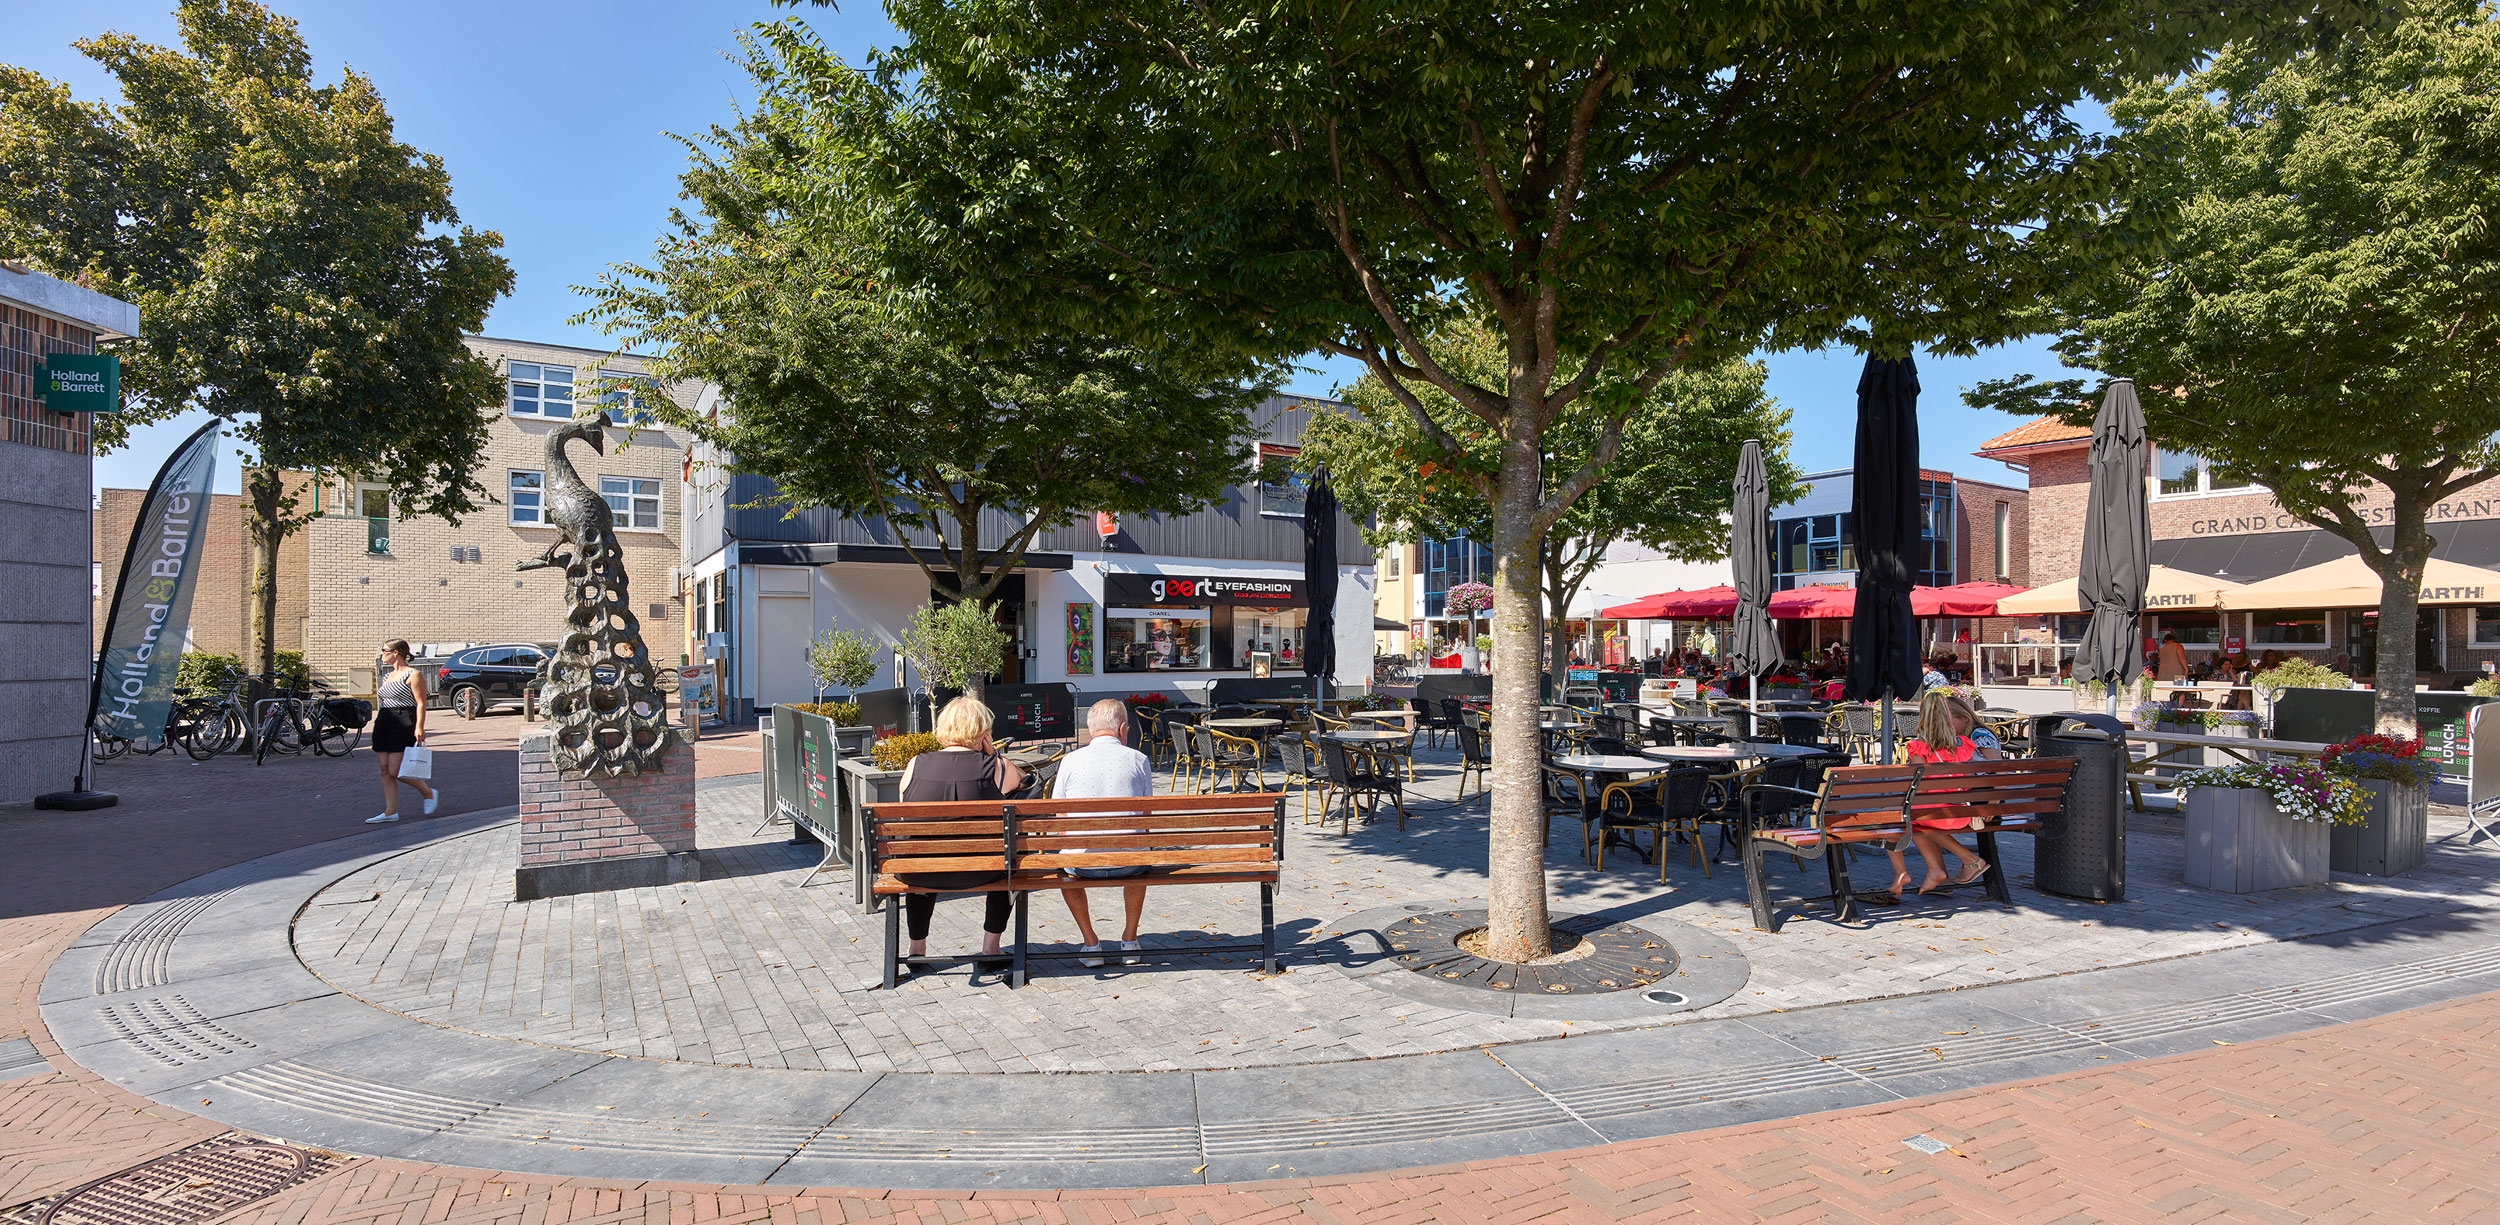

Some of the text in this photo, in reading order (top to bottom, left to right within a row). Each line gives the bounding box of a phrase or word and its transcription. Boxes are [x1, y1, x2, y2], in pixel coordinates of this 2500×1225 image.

[51, 370, 99, 382] Holland
[2192, 516, 2266, 534] GRAND
[1151, 578, 1291, 602] geert EYEFASHION
[2419, 586, 2480, 599] ARTH
[2145, 594, 2193, 605] ARTH
[111, 604, 169, 719] Holland
